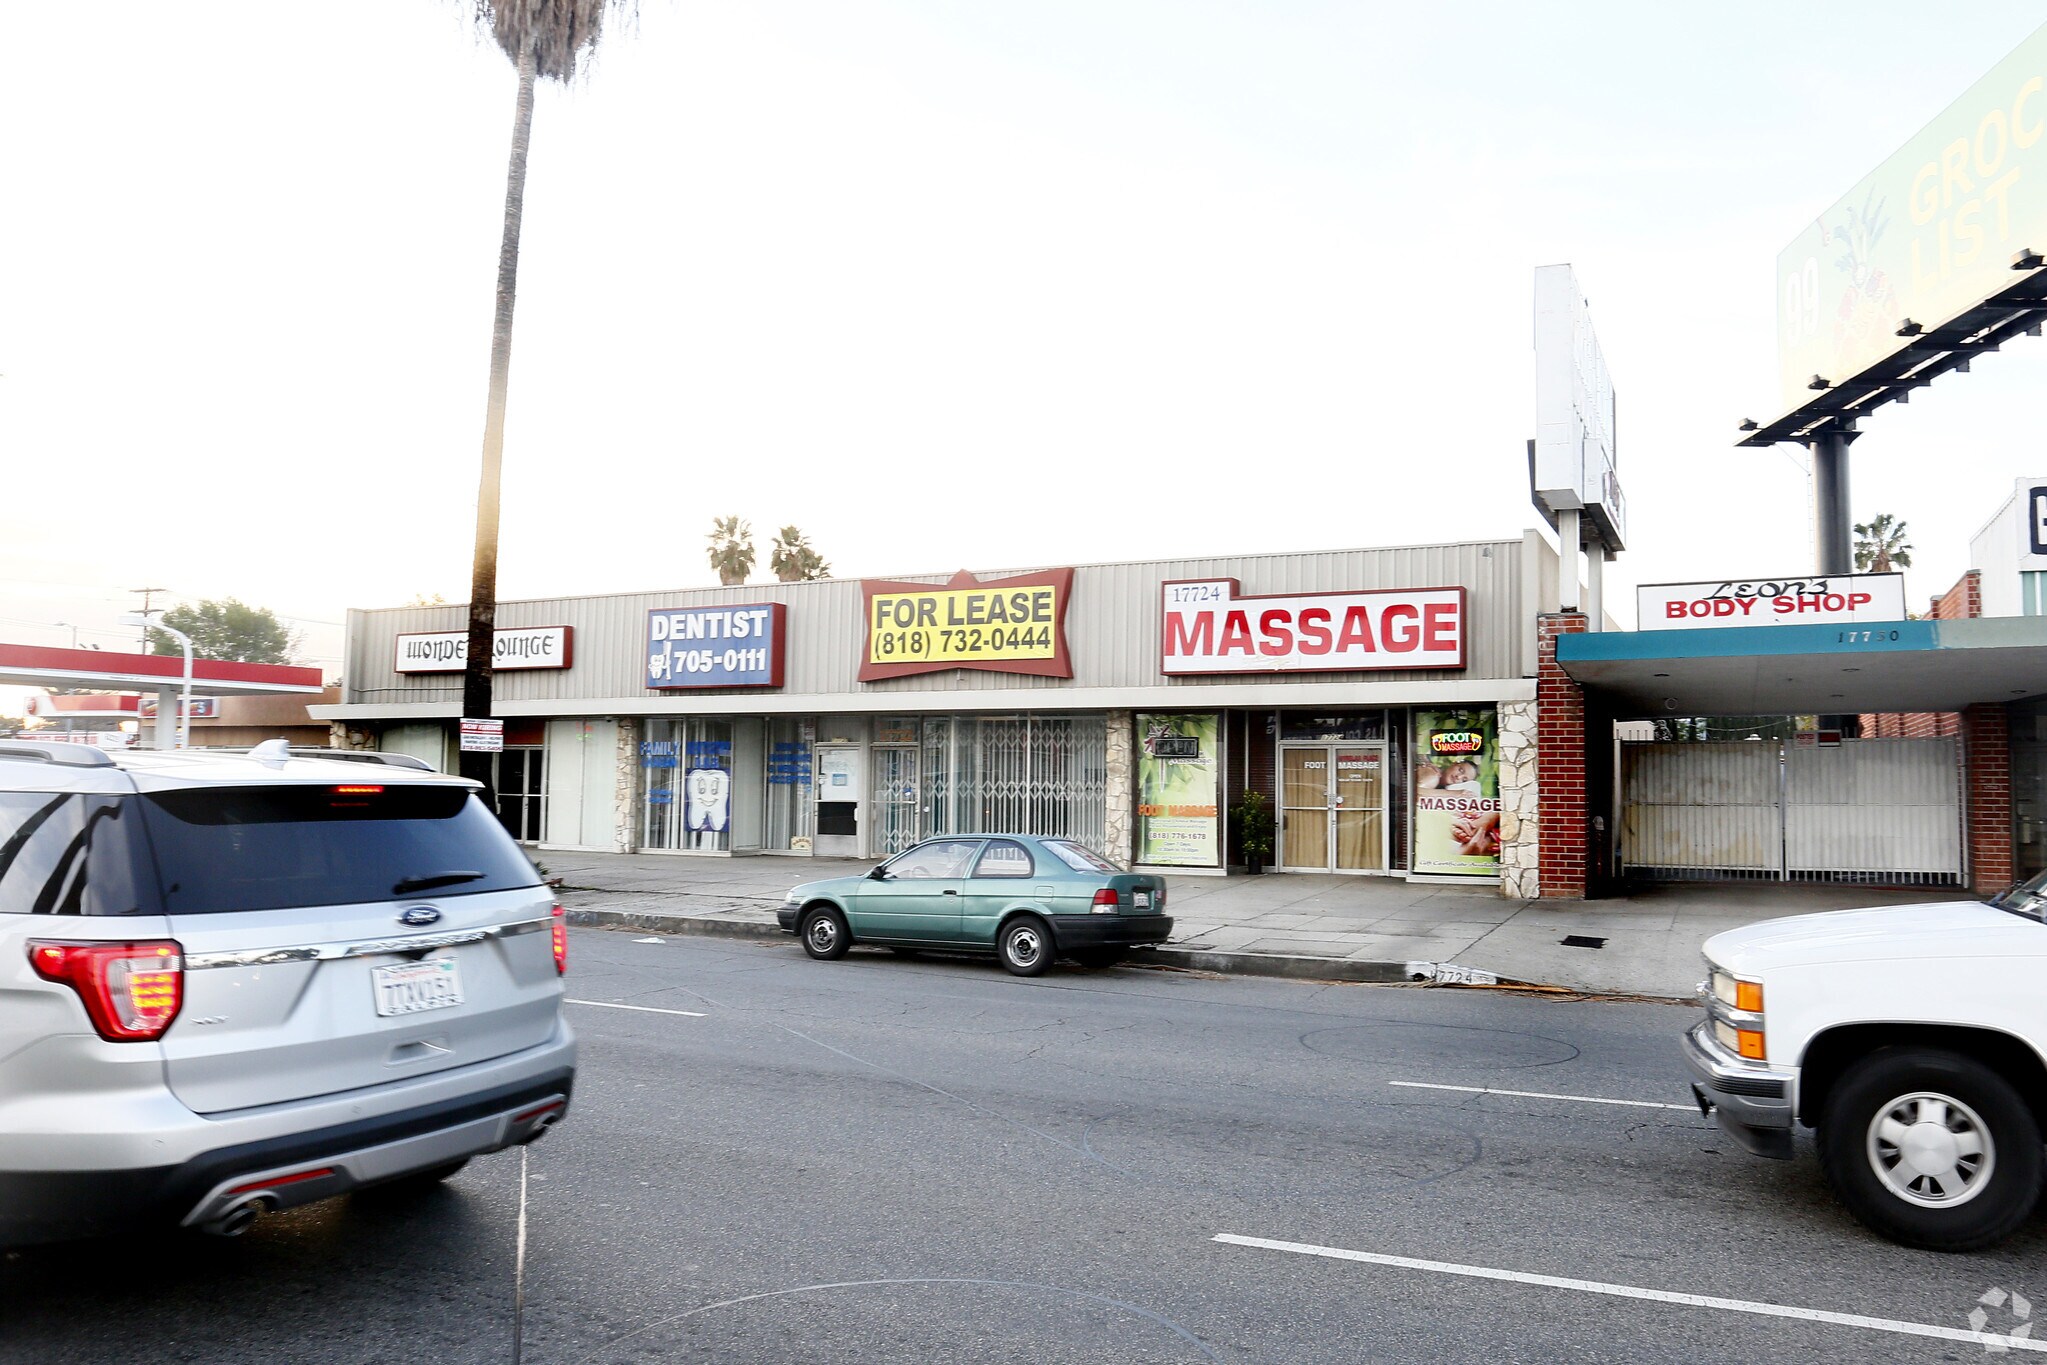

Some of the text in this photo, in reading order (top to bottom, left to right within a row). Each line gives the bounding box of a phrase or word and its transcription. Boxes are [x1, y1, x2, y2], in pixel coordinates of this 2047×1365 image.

[1911, 166, 2021, 287] LIST
[1173, 585, 1221, 603] 17724
[876, 591, 1053, 629] FOR LEASE
[1666, 593, 1872, 618] BODY SHOP
[651, 609, 769, 641] DENTIST
[1164, 603, 1459, 657] MASSAGE
[407, 634, 554, 662] WONDE OUNGE
[875, 625, 1051, 661] (818) 732-0444
[673, 647, 767, 673] 705-0111
[640, 741, 681, 756] FAMILY
[1441, 742, 1473, 751] MASSAGE
[1442, 733, 1471, 743] FOOT
[1303, 761, 1326, 769] FOOT
[1338, 761, 1379, 769] MASSAGE
[1137, 804, 1164, 817] FOOT
[1420, 798, 1503, 812] MASSAGE
